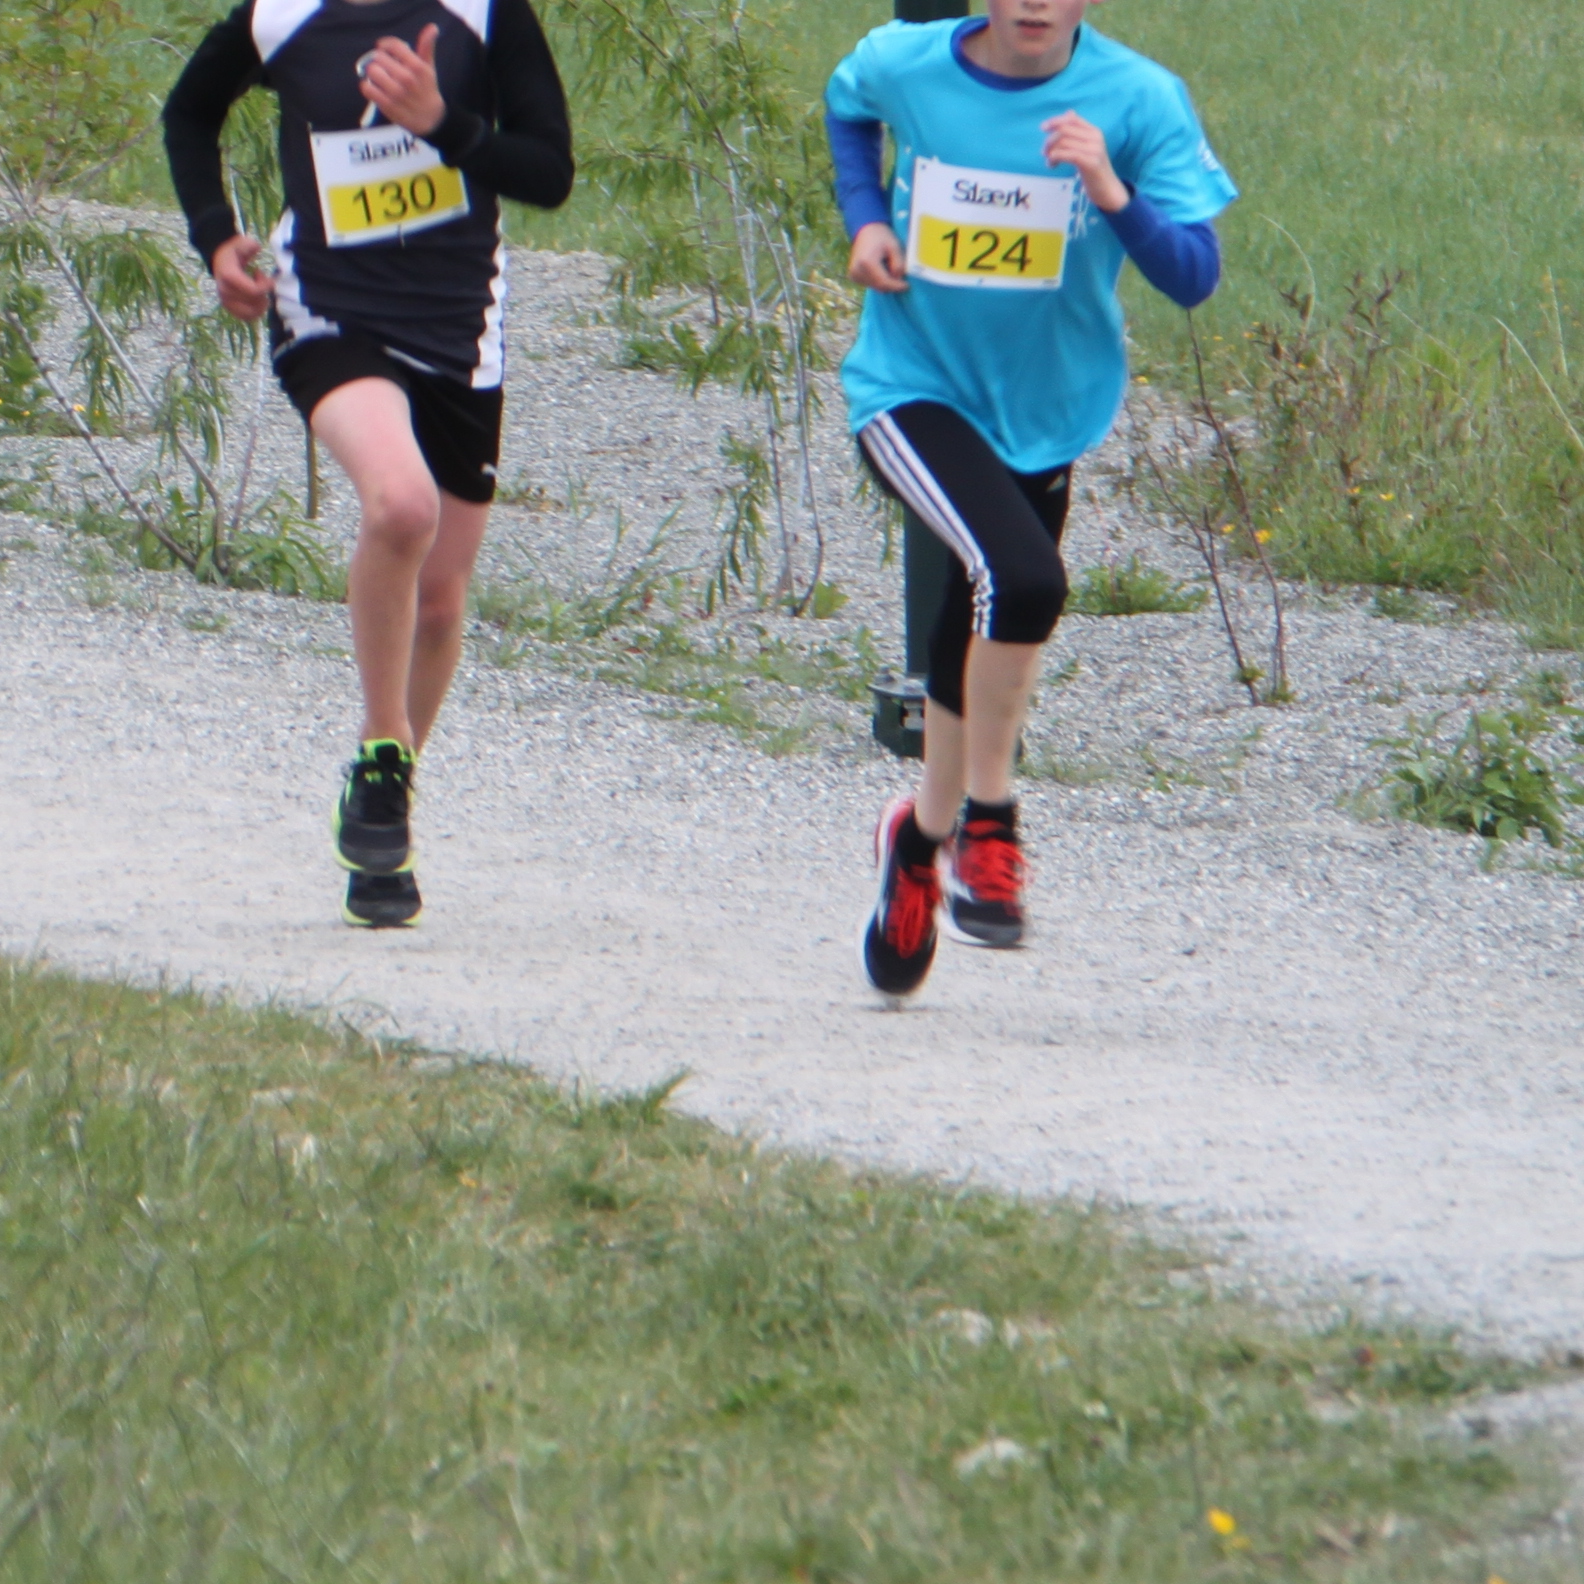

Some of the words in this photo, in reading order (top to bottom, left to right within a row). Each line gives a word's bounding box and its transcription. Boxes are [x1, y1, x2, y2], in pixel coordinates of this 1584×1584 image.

[348, 133, 420, 164] Stærk
[352, 173, 437, 226] 130
[952, 178, 1031, 210] Stærk
[941, 227, 1032, 274] 124
